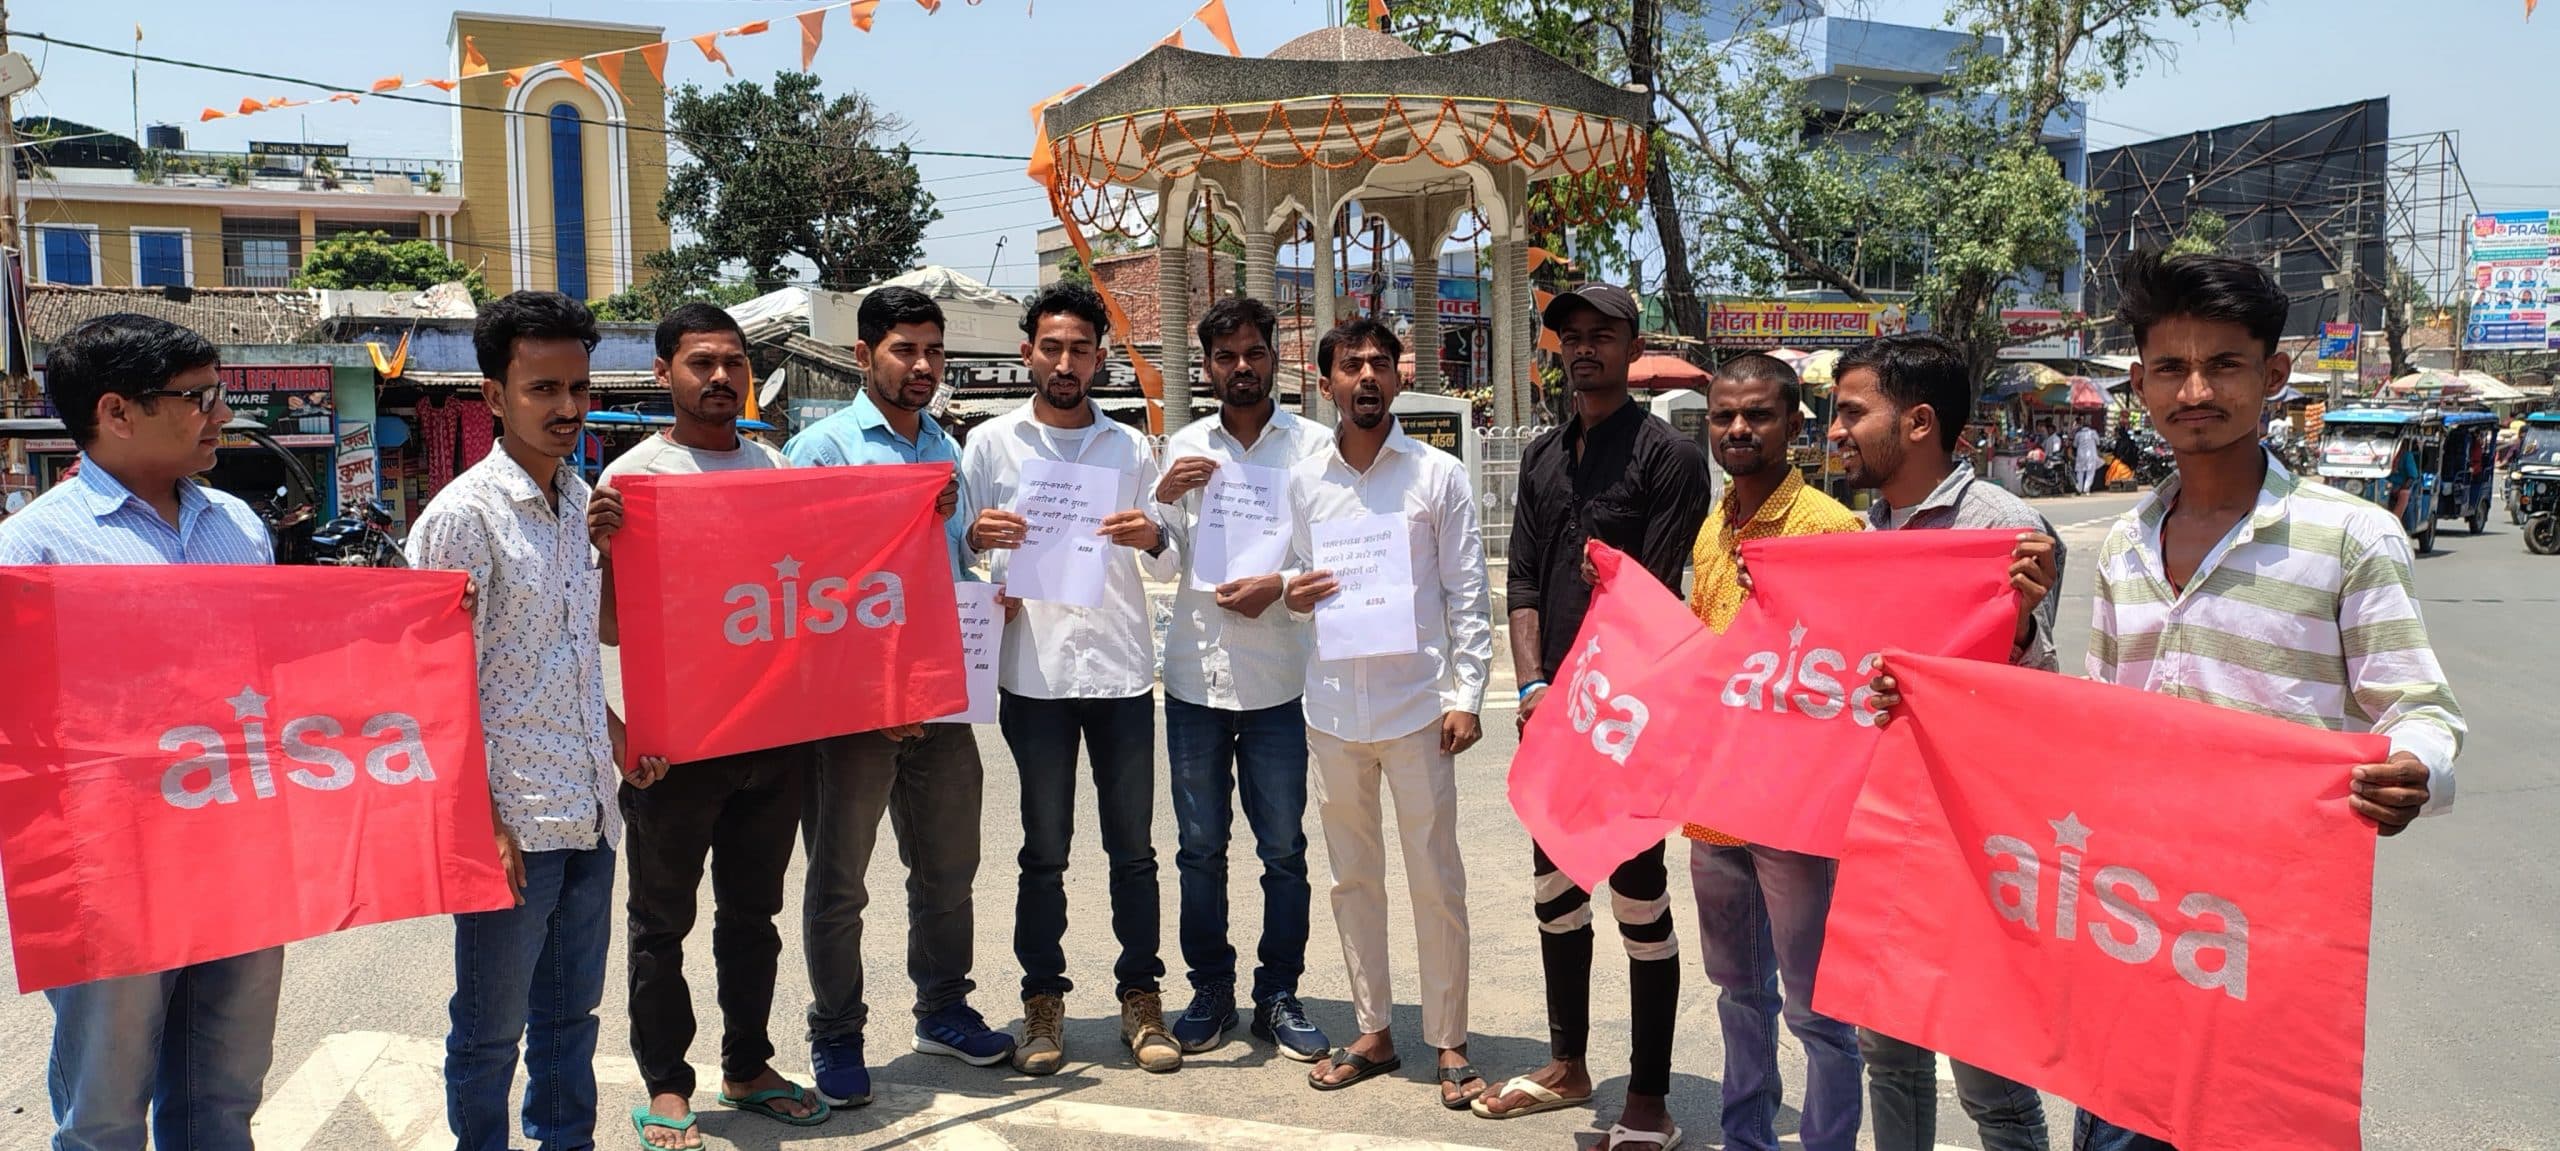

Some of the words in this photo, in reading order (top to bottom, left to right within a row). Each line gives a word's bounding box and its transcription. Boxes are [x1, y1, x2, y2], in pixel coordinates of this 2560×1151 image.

[1708, 304, 1756, 334] होटल
[1762, 303, 1787, 334] माँ
[246, 369, 330, 392] REPAIRING
[225, 394, 270, 405] WARE
[339, 457, 374, 483] कुमार
[1078, 545, 1093, 553] AISA
[723, 554, 906, 646] aisa
[1365, 597, 1387, 607] AISA
[1567, 634, 1650, 768] isa
[158, 685, 437, 809] aisa
[1984, 812, 2249, 1000] aisa
